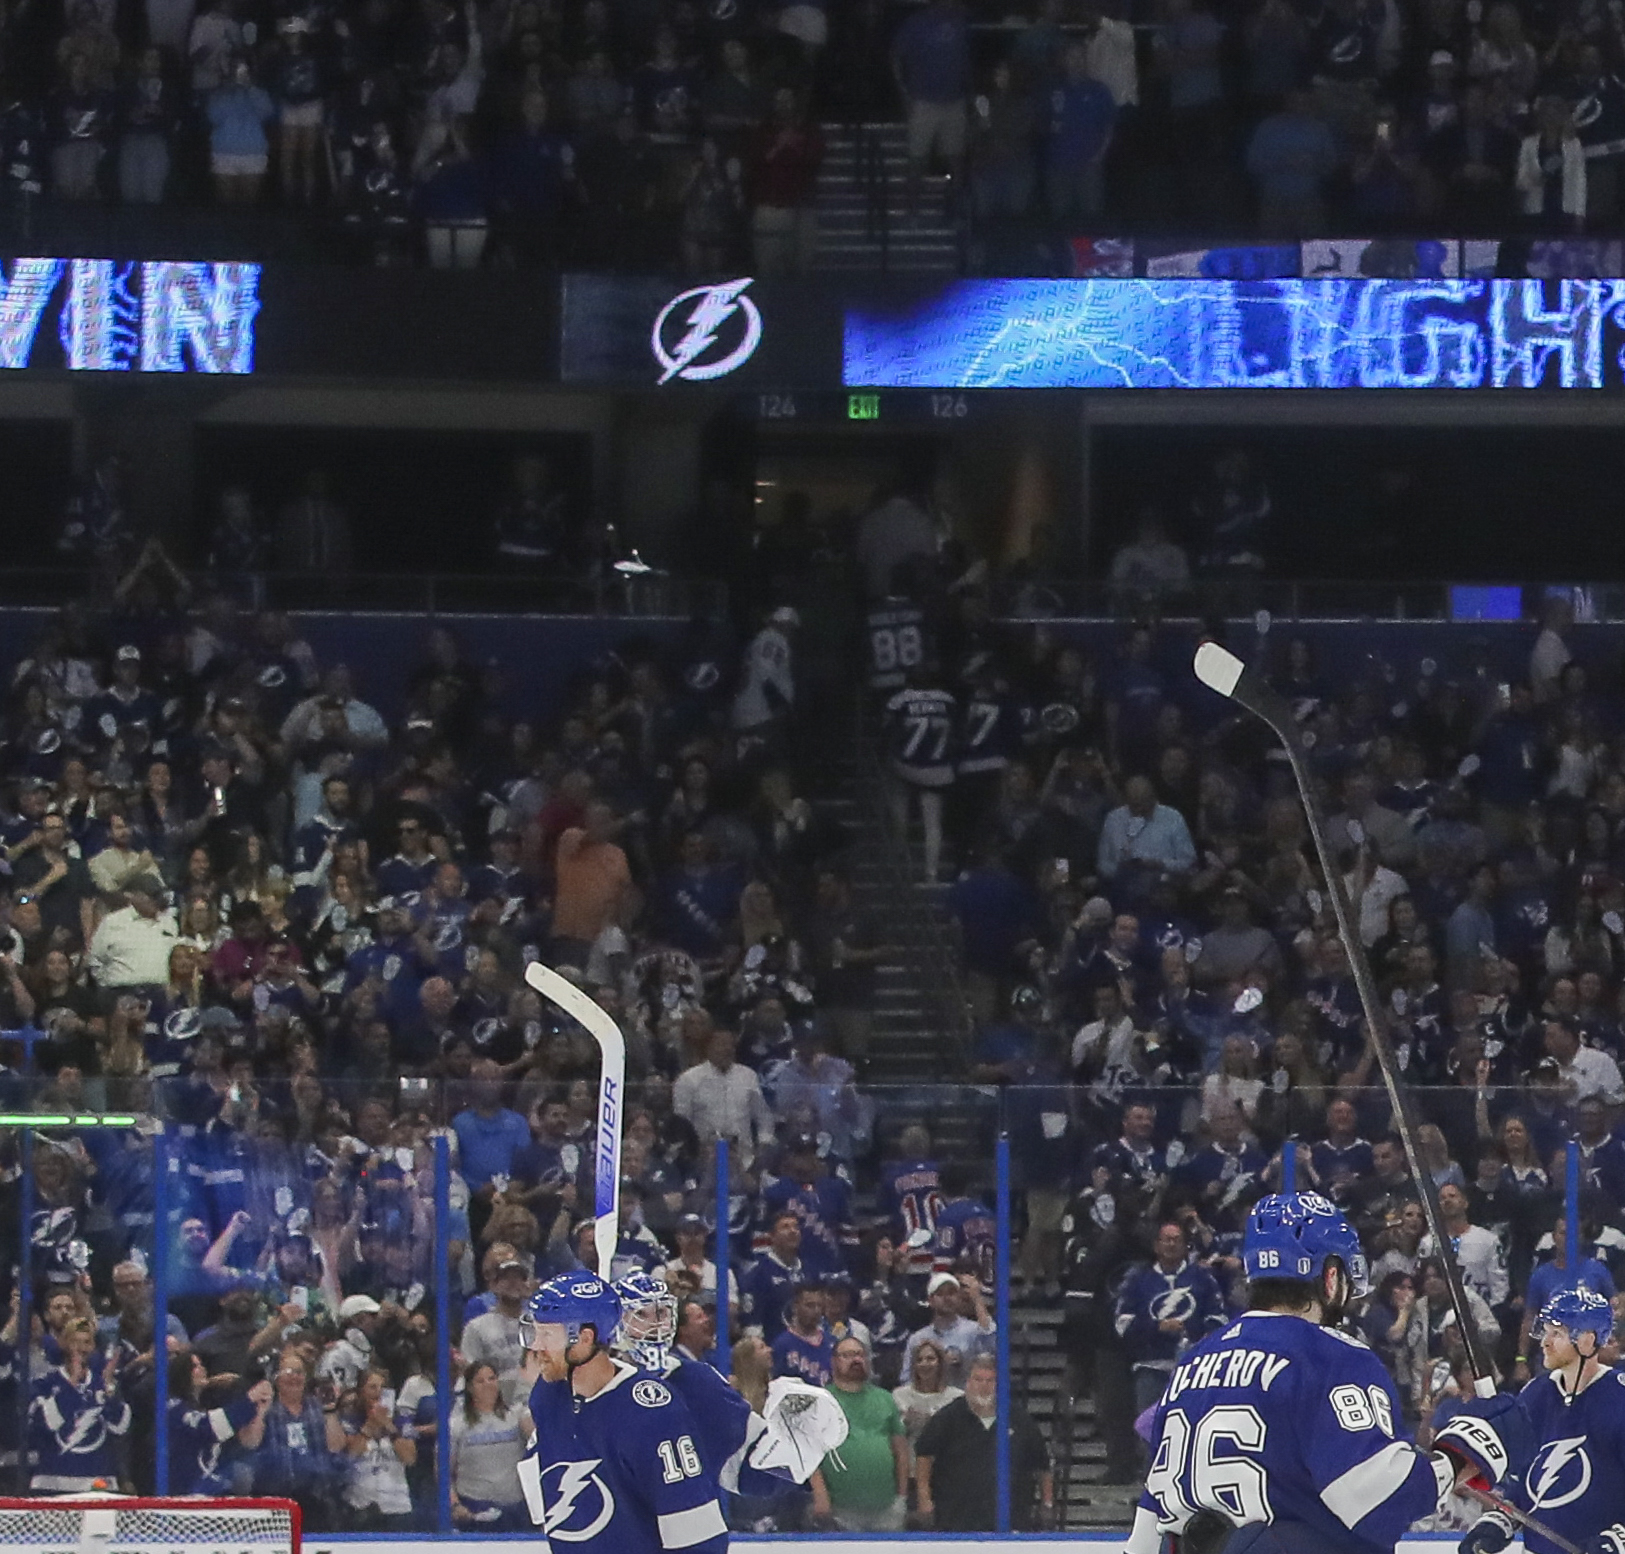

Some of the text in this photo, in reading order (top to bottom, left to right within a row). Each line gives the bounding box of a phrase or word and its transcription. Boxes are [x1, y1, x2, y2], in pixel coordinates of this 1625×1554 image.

[1258, 1250, 1280, 1269] 86
[1329, 1383, 1395, 1439] 86
[657, 1436, 703, 1484] 16
